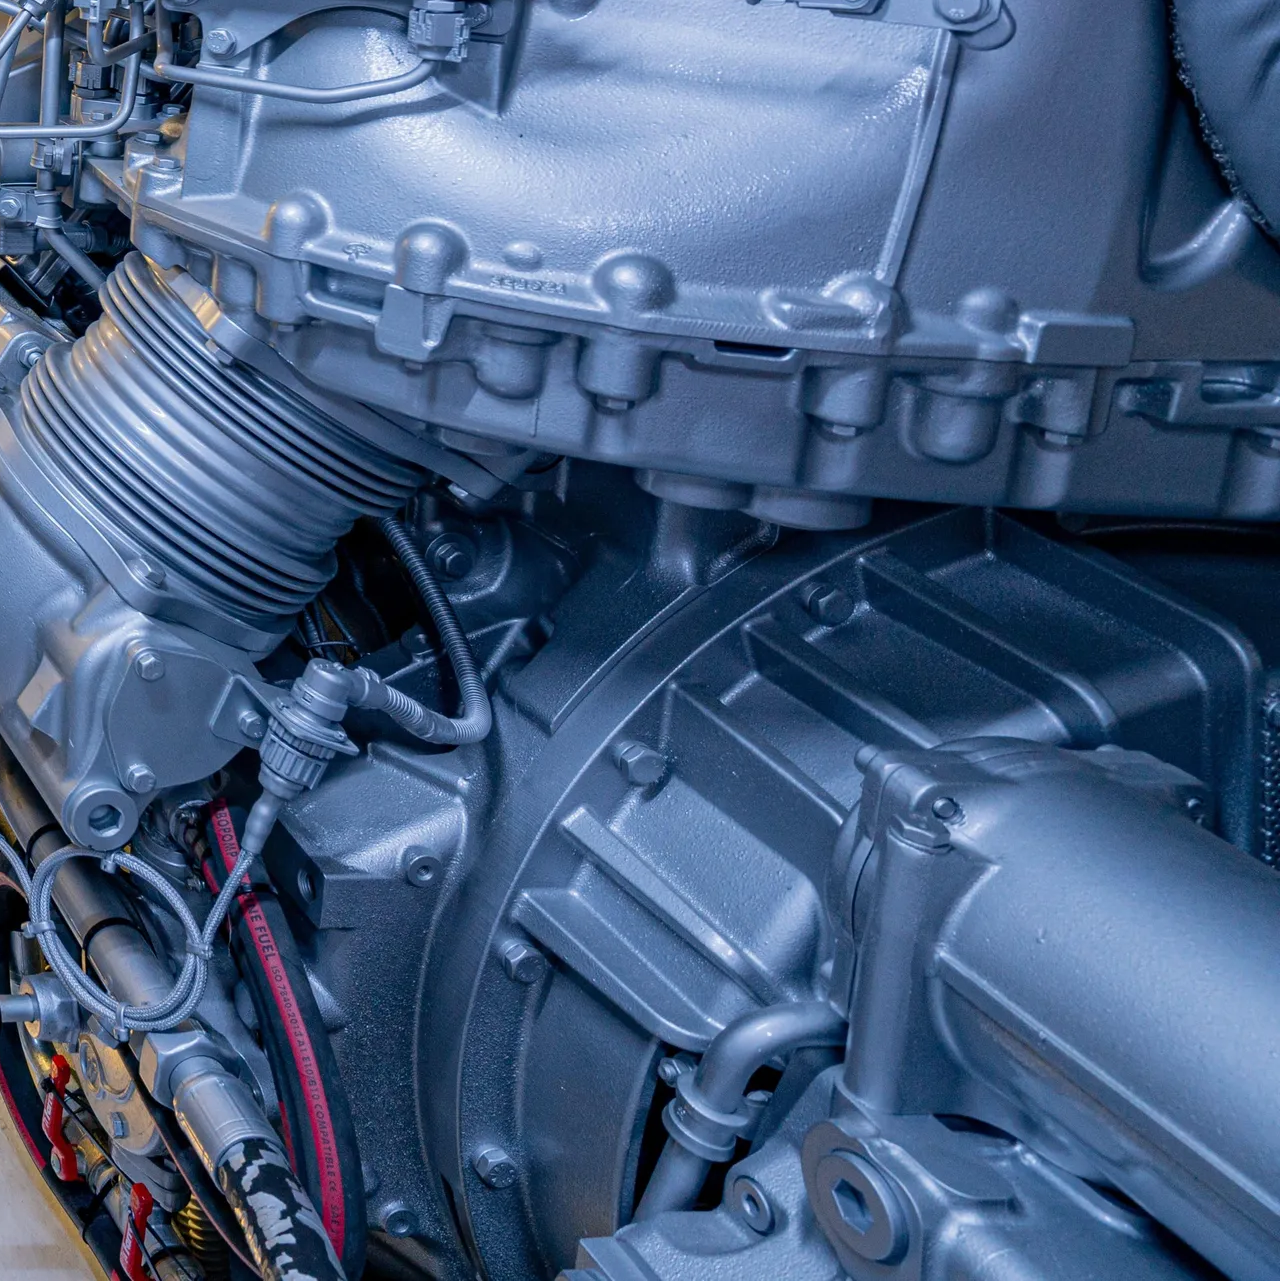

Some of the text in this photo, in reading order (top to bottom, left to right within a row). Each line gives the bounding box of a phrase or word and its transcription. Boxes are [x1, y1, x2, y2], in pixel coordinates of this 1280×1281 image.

[255, 926, 276, 961] FUEL
[271, 965, 283, 982] ISO
[314, 1104, 337, 1177] COMPATIBLE
